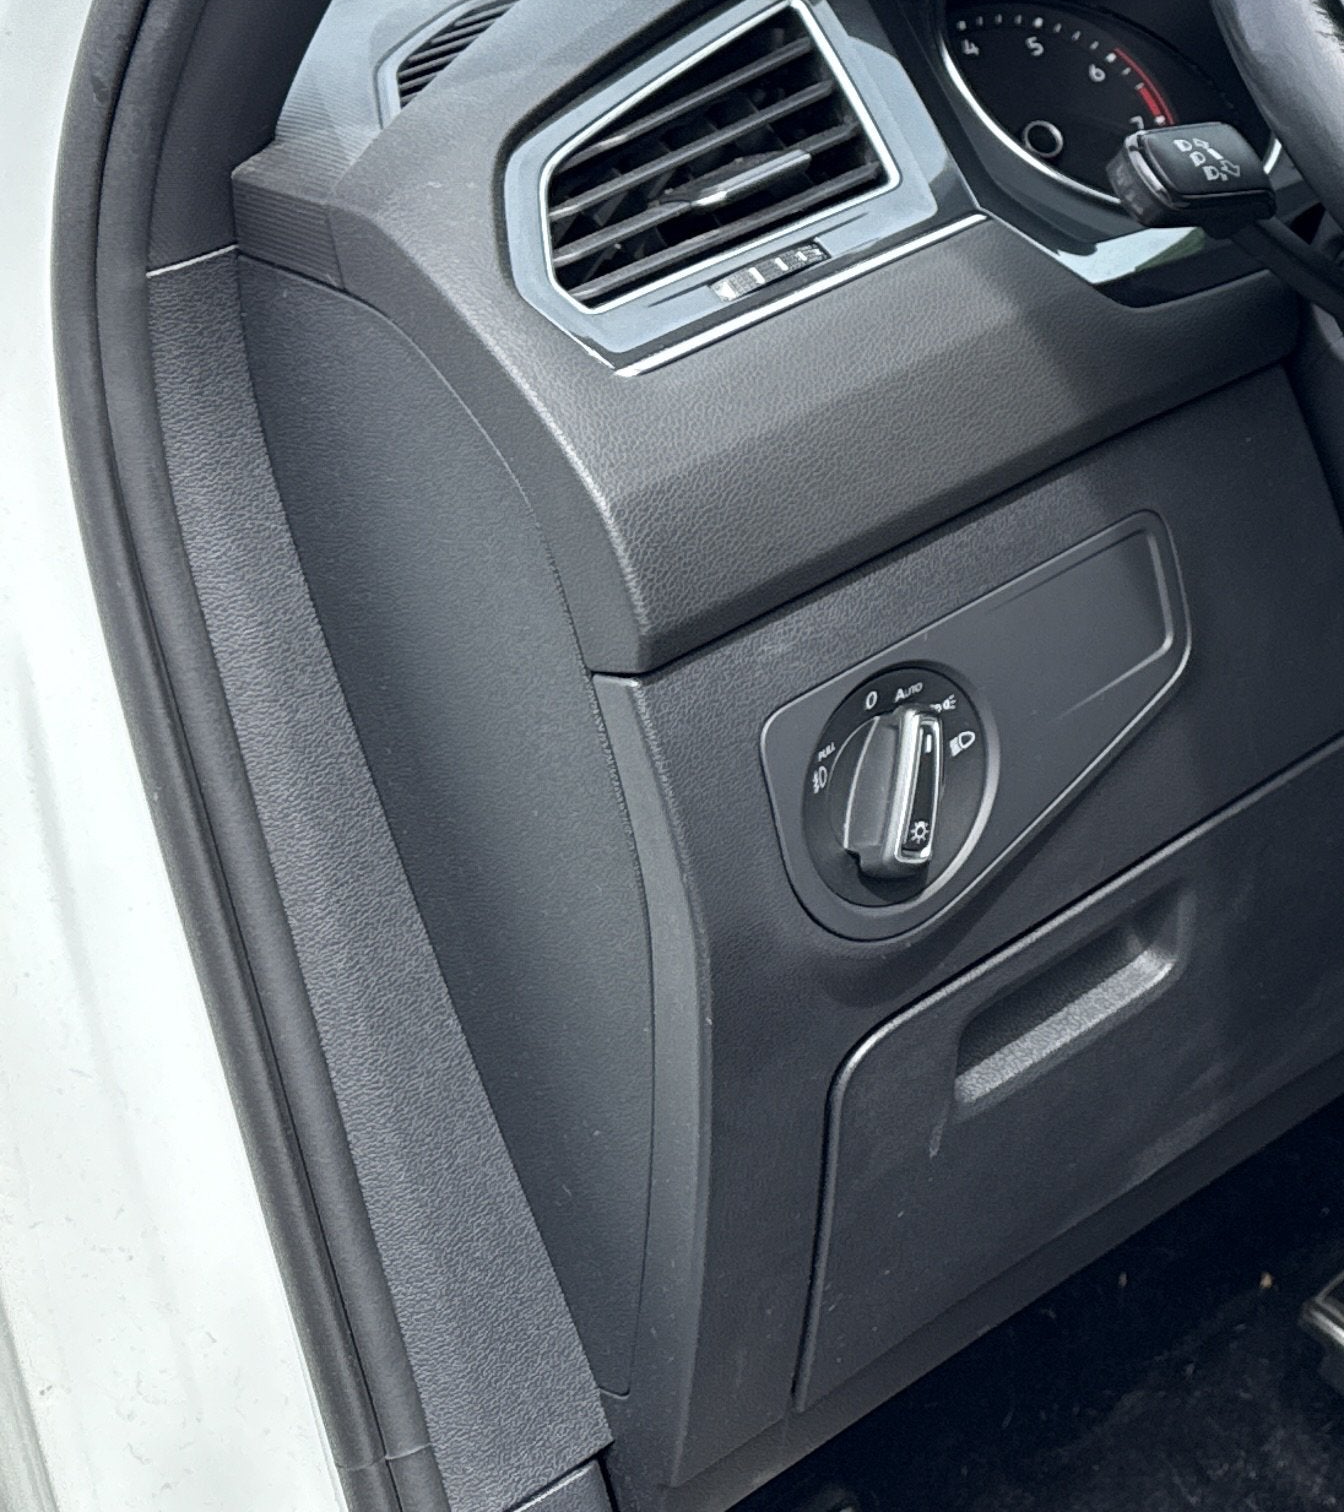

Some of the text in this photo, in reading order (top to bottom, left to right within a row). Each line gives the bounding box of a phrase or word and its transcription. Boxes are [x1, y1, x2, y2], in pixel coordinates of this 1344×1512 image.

[961, 39, 981, 57] 4
[1025, 36, 1045, 57] 5
[1088, 63, 1106, 83] 6
